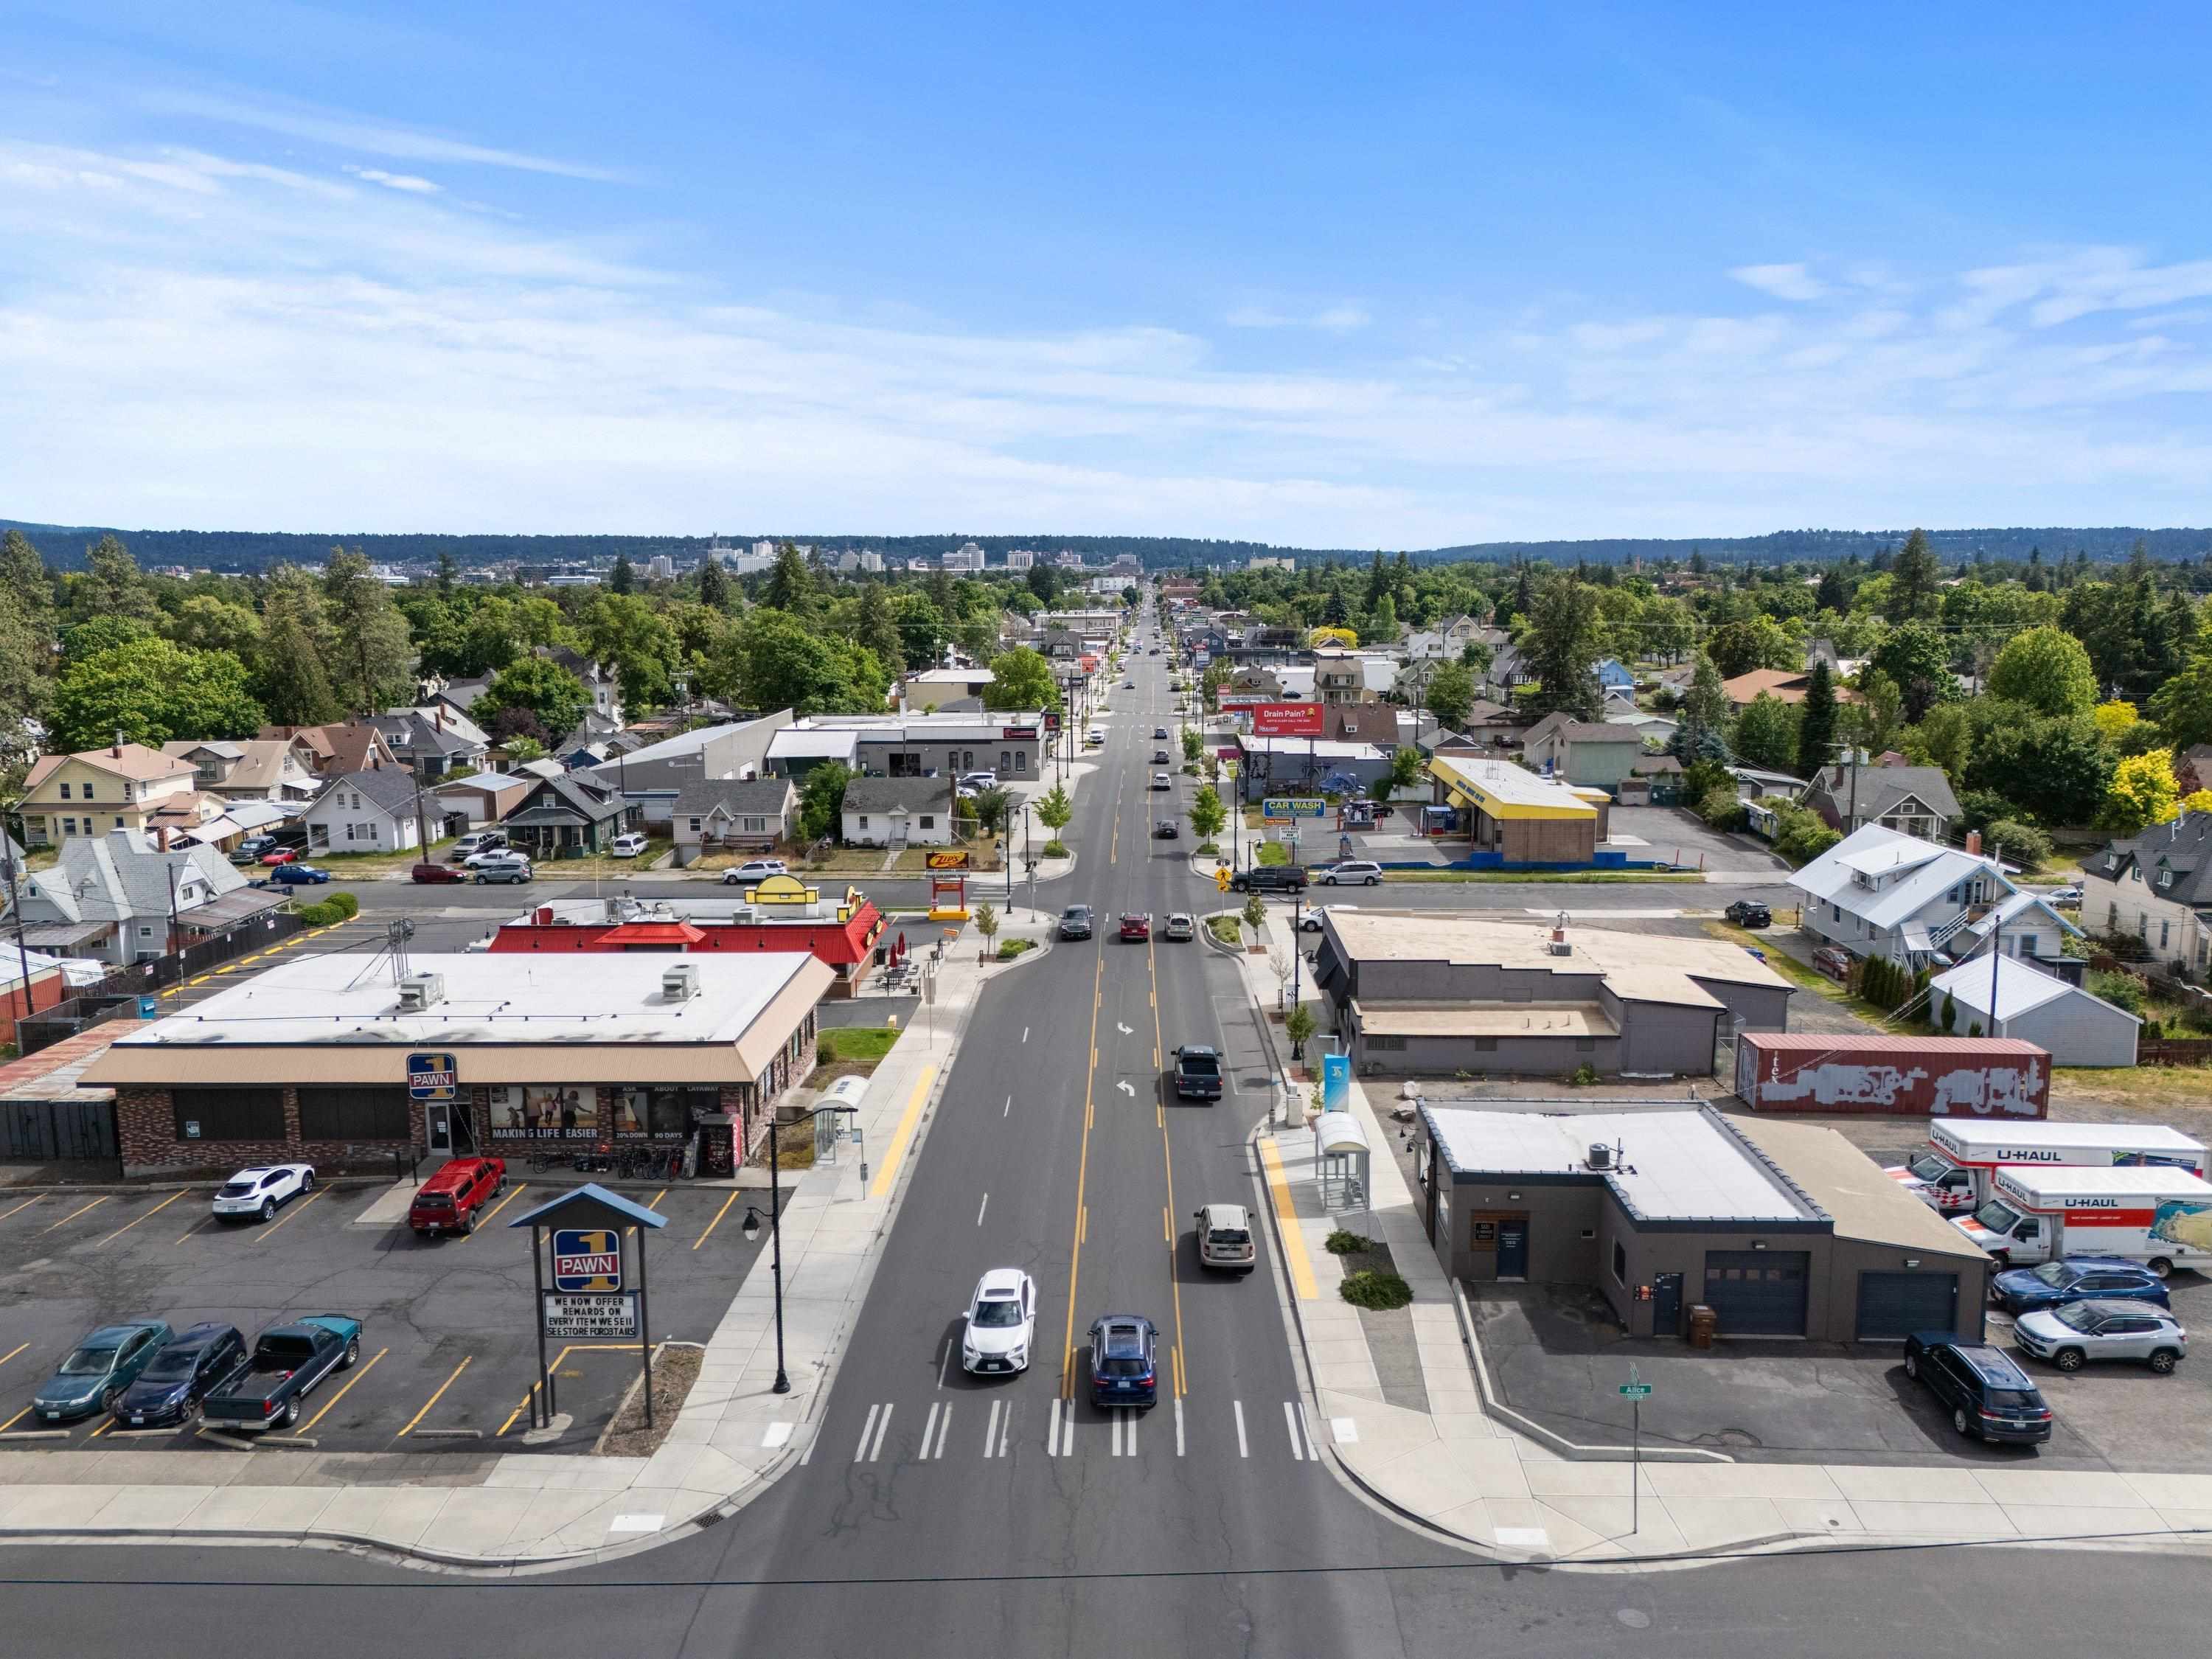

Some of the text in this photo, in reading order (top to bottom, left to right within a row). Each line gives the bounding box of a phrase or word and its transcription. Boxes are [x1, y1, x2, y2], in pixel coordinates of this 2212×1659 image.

[413, 1073, 450, 1086] PAWN
[493, 1128, 598, 1138] MAKING LIFE EASIER
[1932, 1129, 1958, 1155] U-HAUL
[1997, 1150, 2062, 1161] U-HAUL
[1998, 1177, 2027, 1202] U-HAUL
[2065, 1198, 2118, 1207] U-HAUL
[561, 1256, 613, 1274] PAWN
[554, 1298, 625, 1306] WE NOW OFFER
[608, 1307, 621, 1316] ON
[548, 1317, 574, 1326] EVERY
[576, 1317, 597, 1326] ITEM
[599, 1317, 613, 1326] WE
[547, 1327, 562, 1336] SEE
[562, 1327, 589, 1336] STORE
